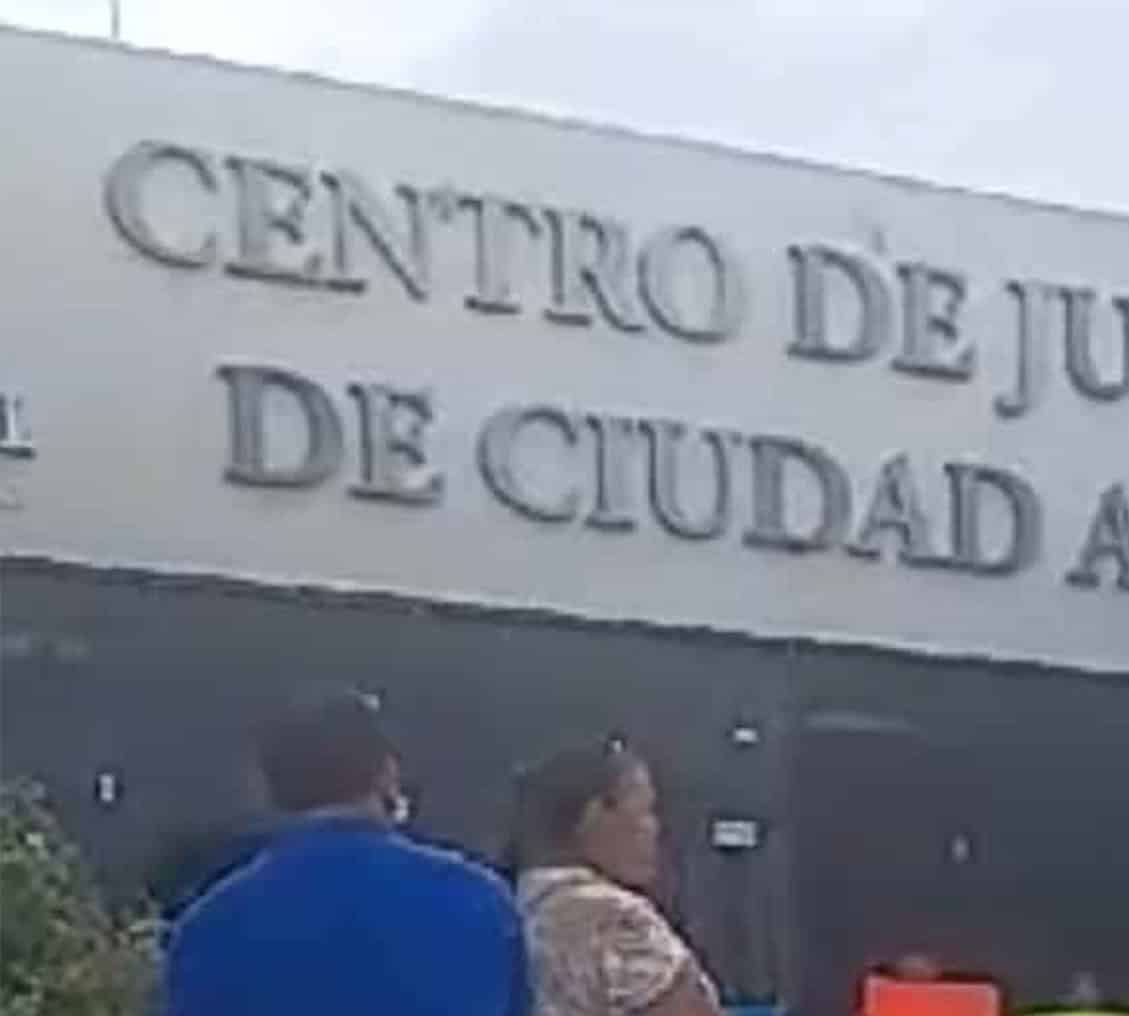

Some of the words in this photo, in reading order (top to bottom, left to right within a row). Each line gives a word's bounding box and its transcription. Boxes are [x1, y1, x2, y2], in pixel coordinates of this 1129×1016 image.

[103, 140, 742, 343] CENTRO
[786, 242, 975, 380] DE
[216, 364, 443, 505] DE
[477, 404, 1042, 578] CIUDAD
